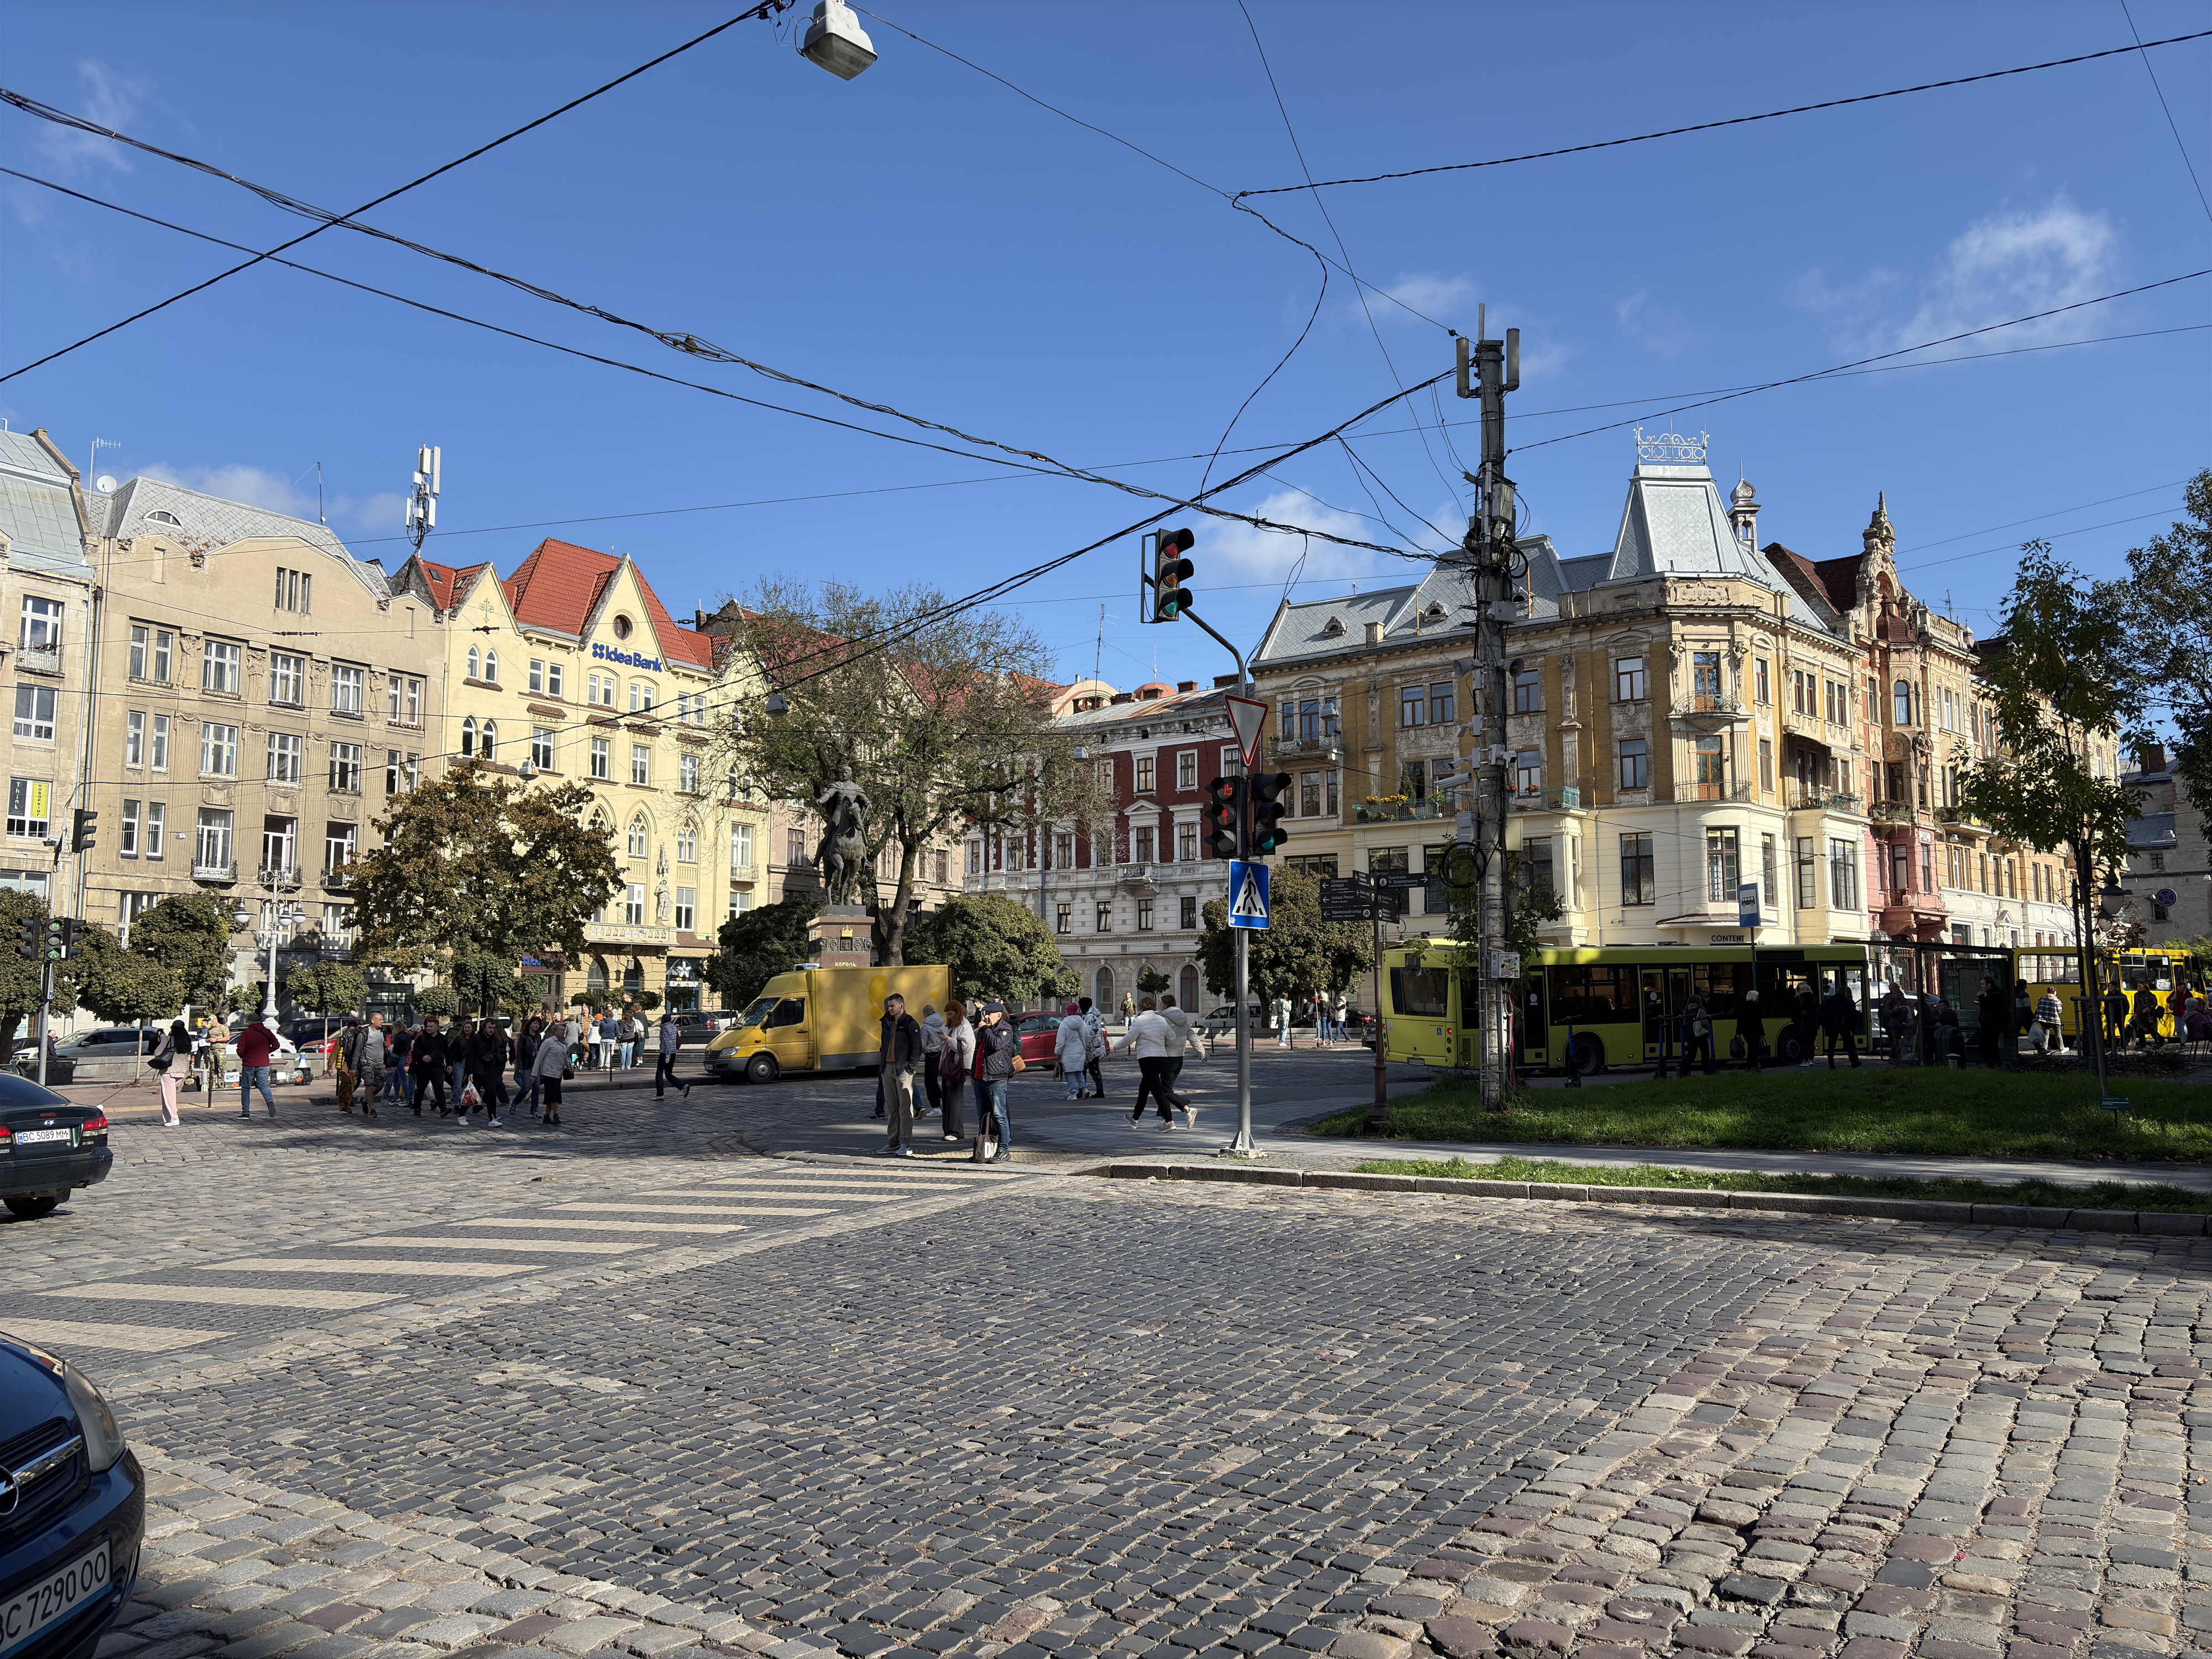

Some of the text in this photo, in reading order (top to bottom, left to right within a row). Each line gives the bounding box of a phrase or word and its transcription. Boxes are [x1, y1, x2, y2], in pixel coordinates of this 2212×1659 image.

[23, 1133, 35, 1141] BC
[37, 1130, 54, 1140] 5089
[28, 1569, 76, 1630] 7290
[81, 1551, 107, 1593] OO
